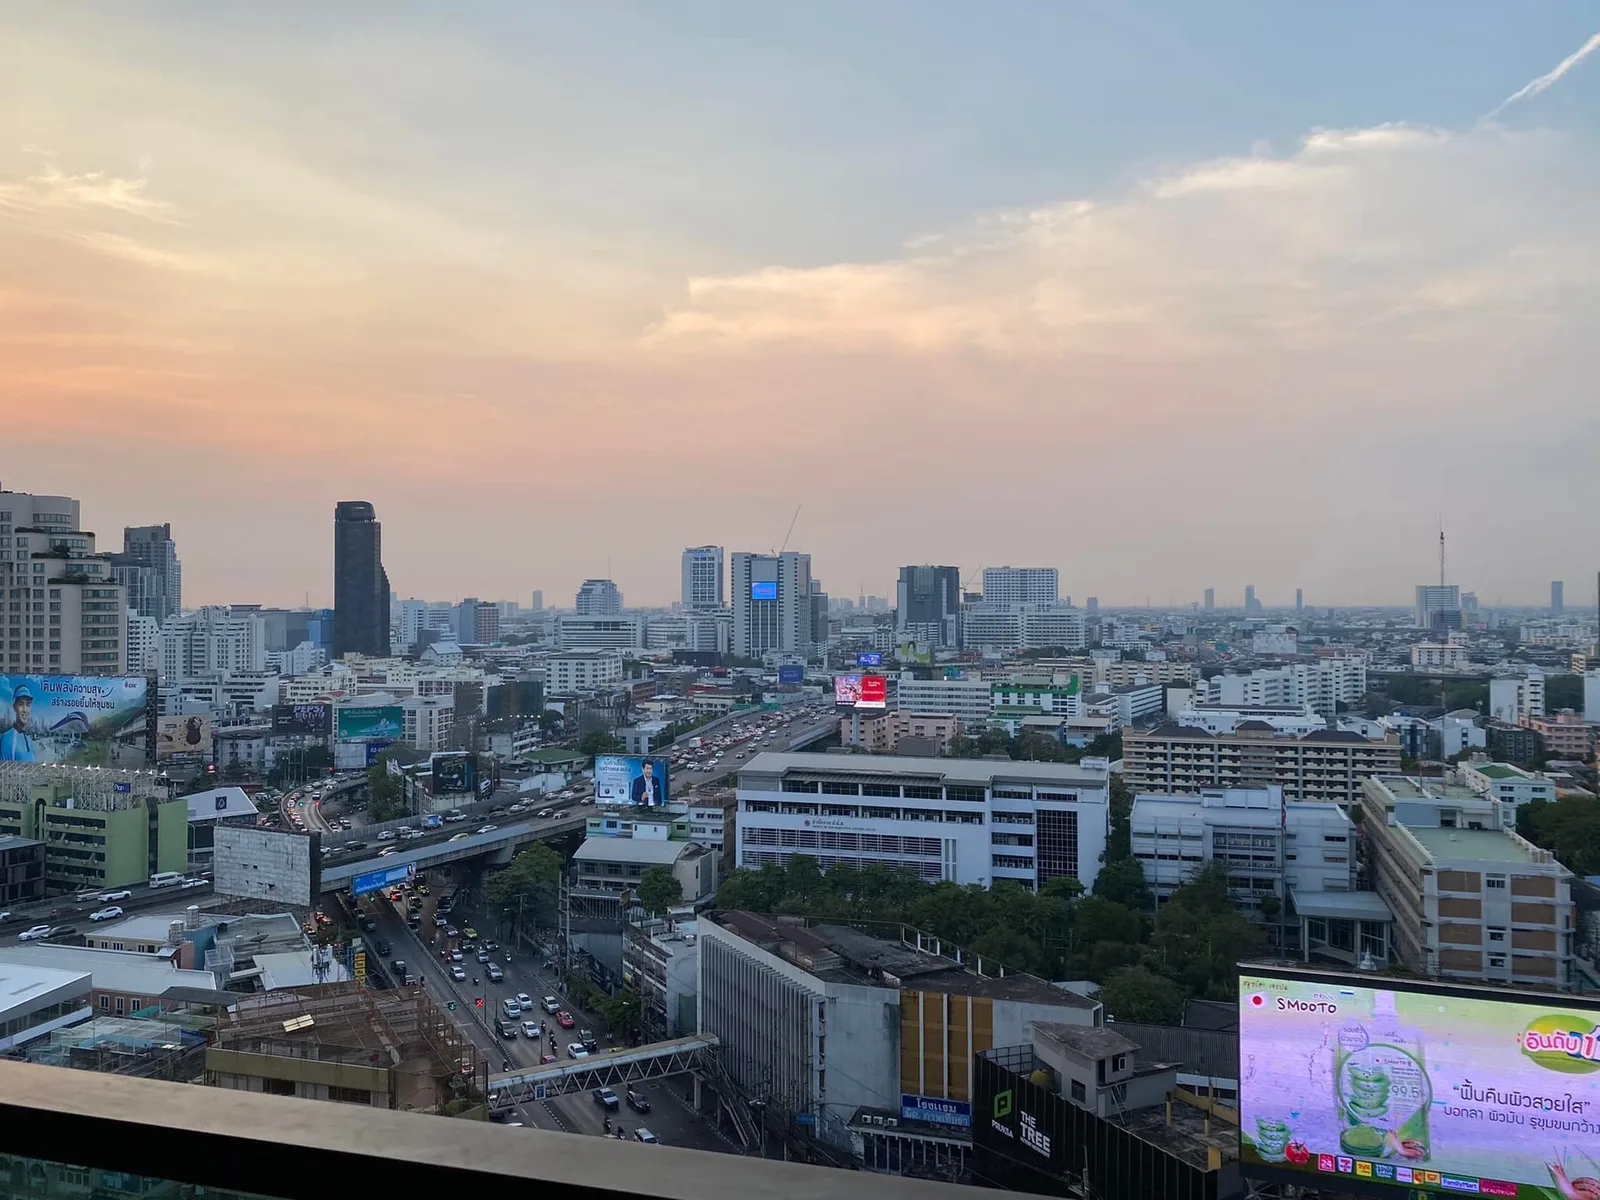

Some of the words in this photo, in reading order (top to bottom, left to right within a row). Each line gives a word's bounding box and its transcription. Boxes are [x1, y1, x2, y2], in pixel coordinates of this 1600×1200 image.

[293, 705, 325, 713] PEPSI
[1526, 1031, 1578, 1051] อันดับ
[916, 1097, 957, 1113] โรงแรม
[1020, 1110, 1036, 1129] THE
[1444, 1106, 1484, 1119] บอกลา
[1489, 1110, 1525, 1125] ผิวมัน
[1020, 1121, 1051, 1153] TREE
